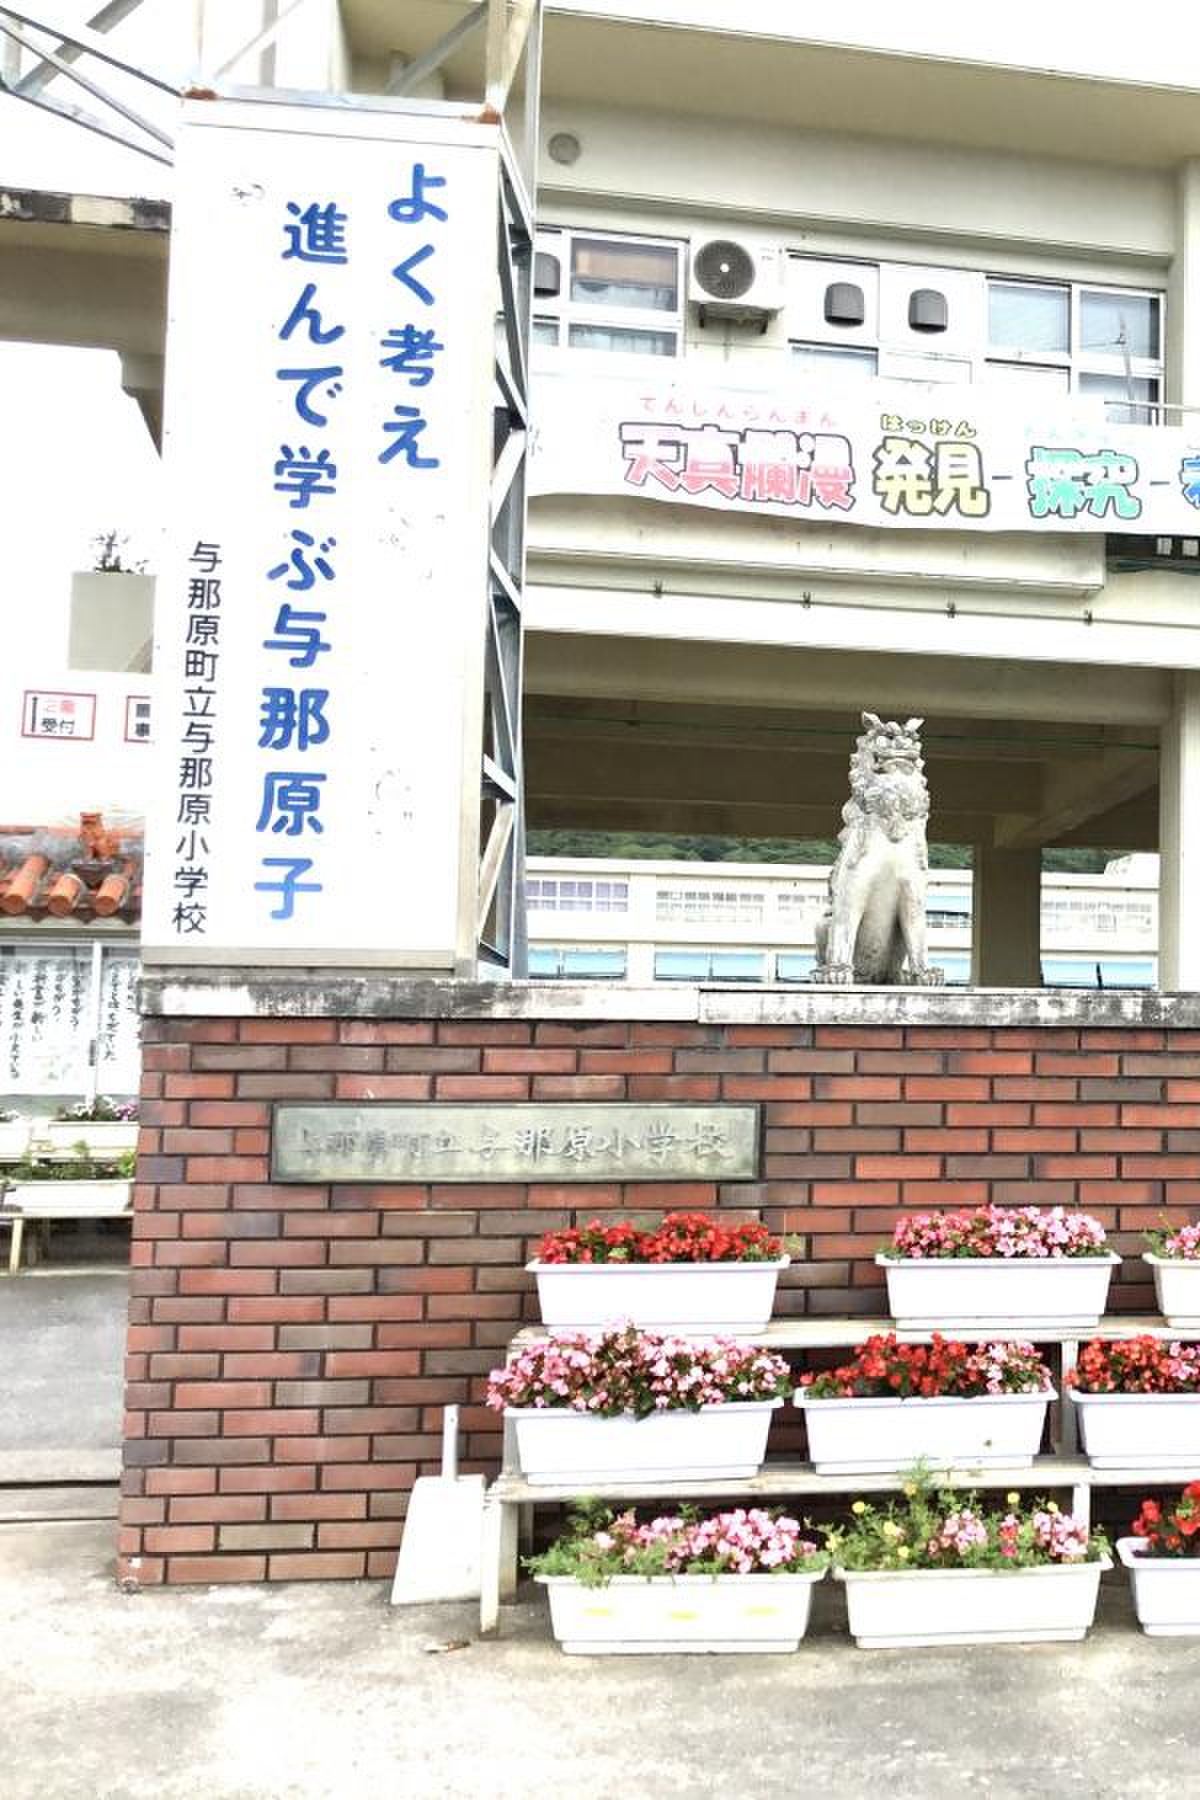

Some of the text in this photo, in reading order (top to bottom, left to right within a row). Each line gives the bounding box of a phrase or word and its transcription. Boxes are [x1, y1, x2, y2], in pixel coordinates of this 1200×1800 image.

[378, 163, 449, 469] よく考え
[880, 413, 977, 438] はっけん
[255, 200, 350, 921] 進んで学ぶ与那原子
[40, 717, 76, 735] 受付
[171, 540, 223, 935] 与那原町立与那原小学校
